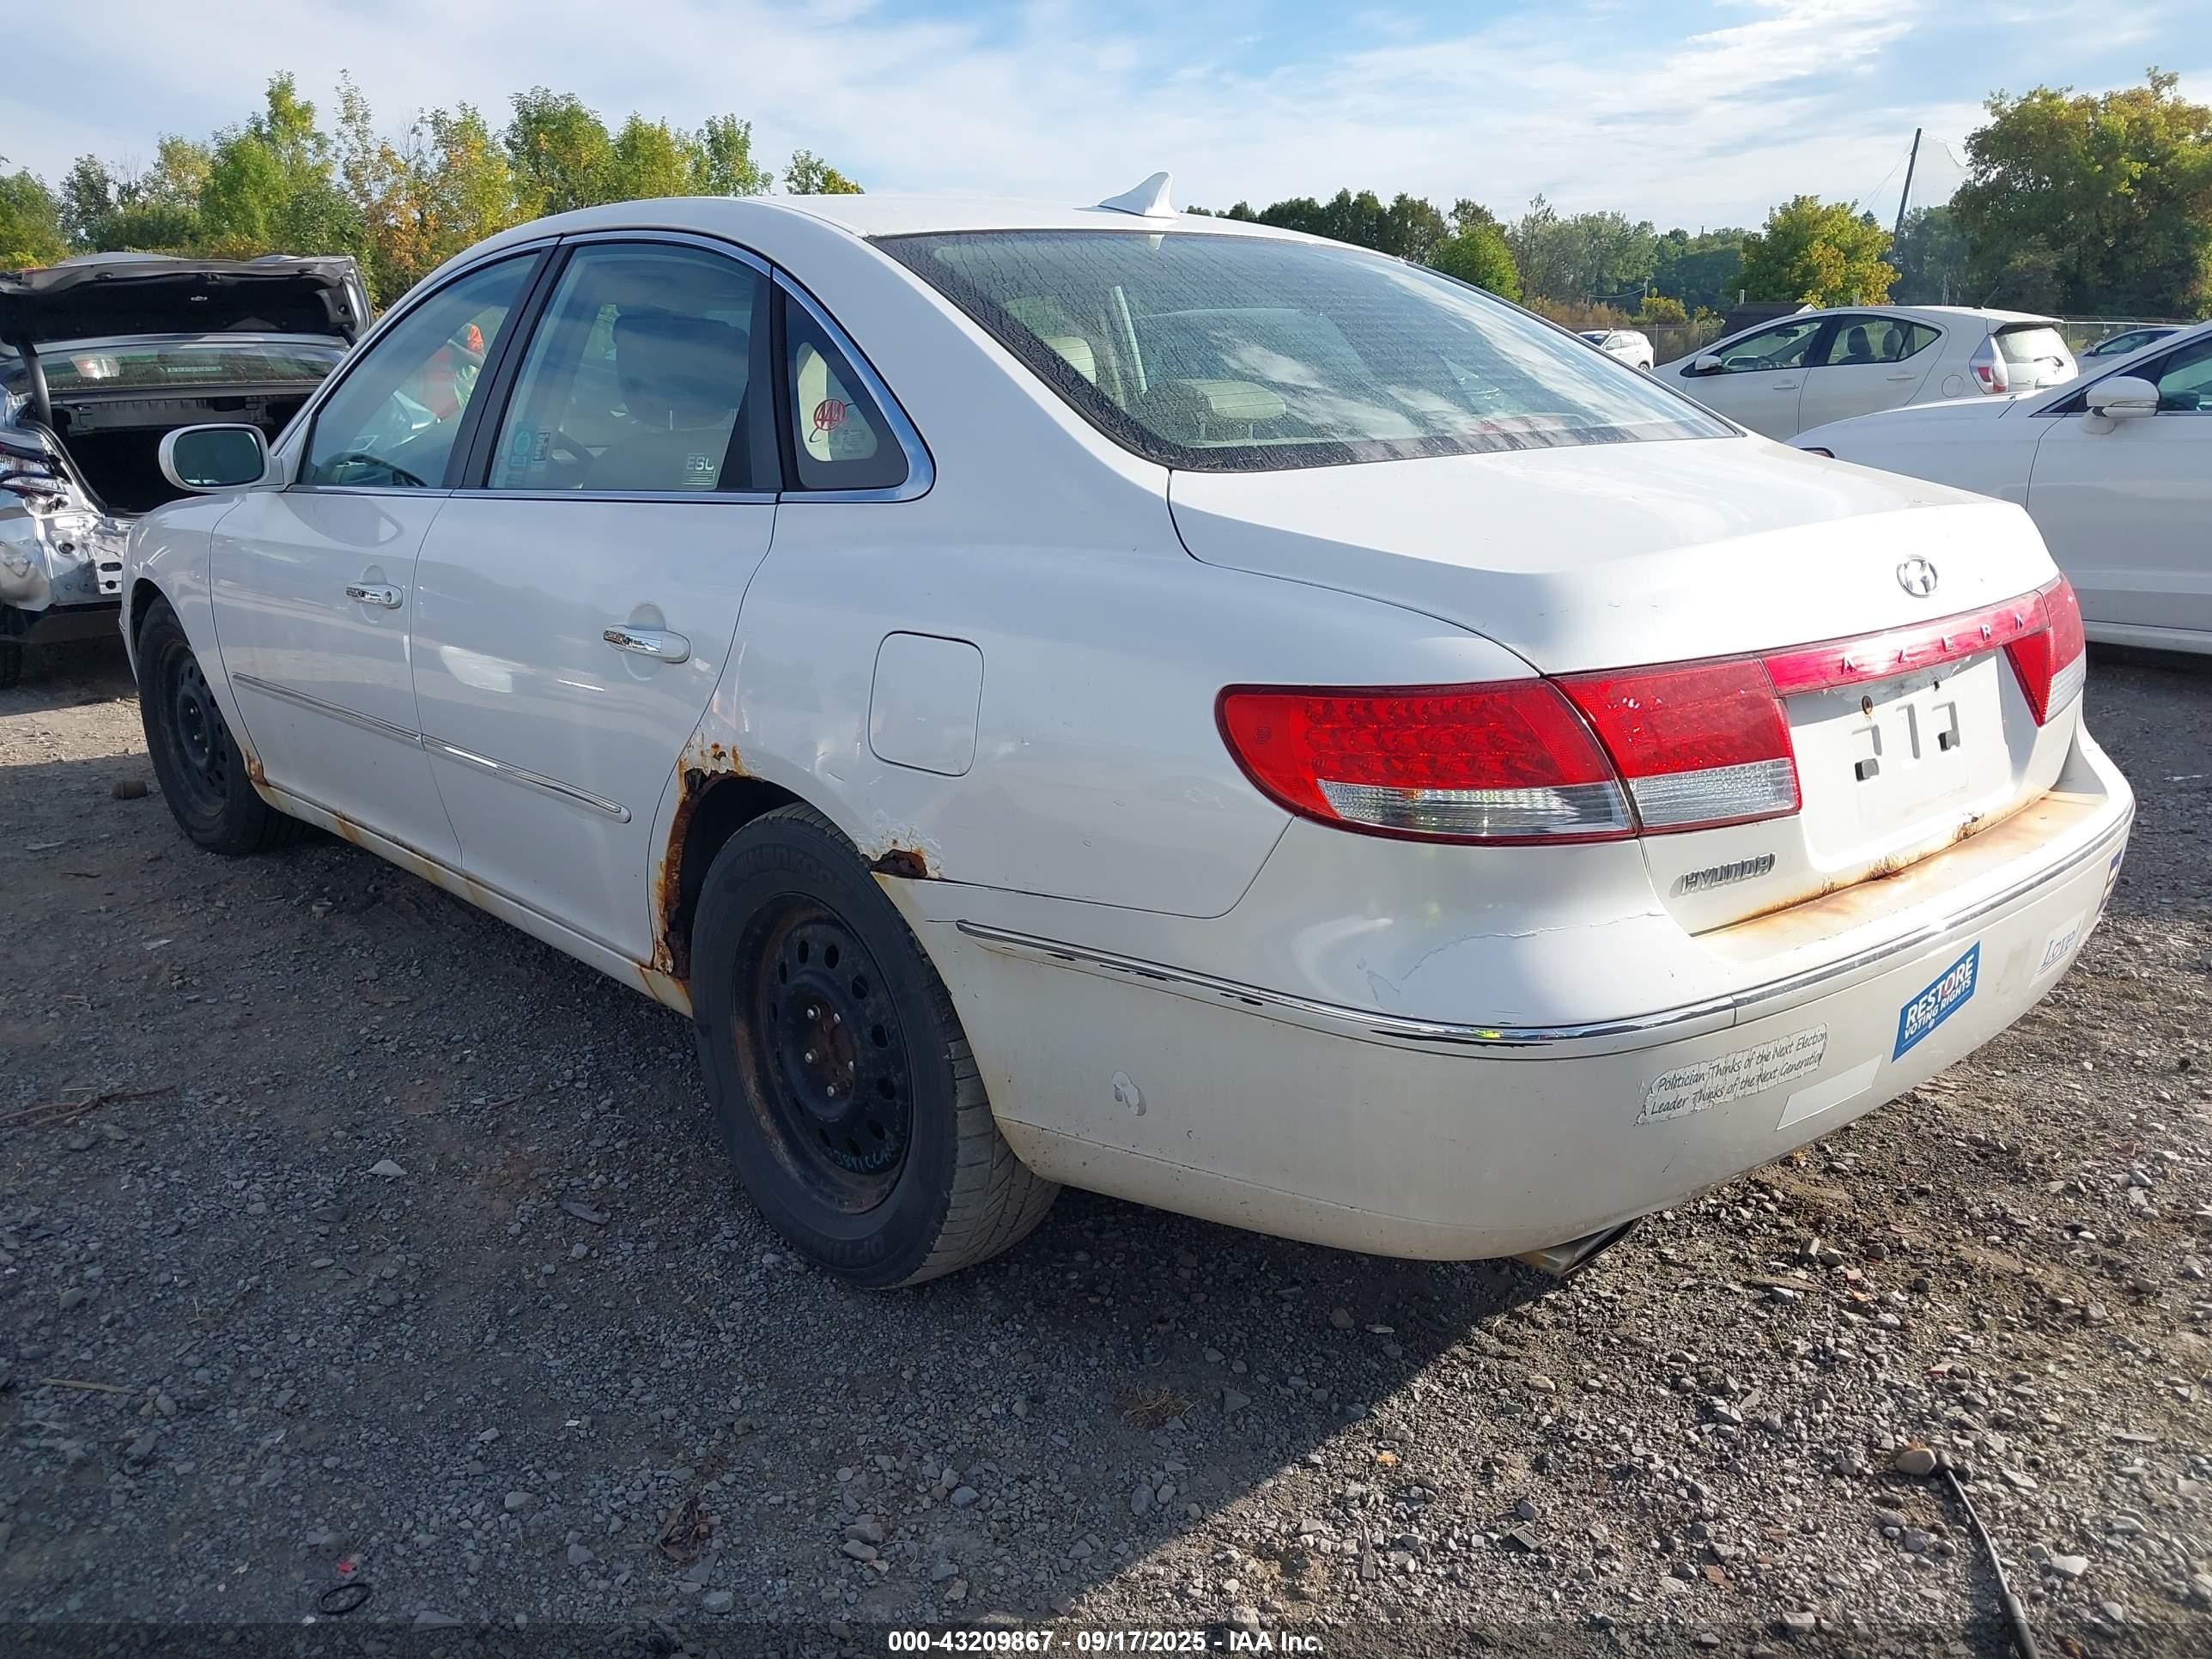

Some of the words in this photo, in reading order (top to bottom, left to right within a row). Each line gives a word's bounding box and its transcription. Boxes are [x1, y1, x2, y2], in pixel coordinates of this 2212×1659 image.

[815, 400, 844, 428] AAA
[1841, 613, 2024, 675] AZERA
[1682, 853, 1776, 894] HYUNDAI
[1905, 953, 1975, 1029] RESTORE
[1905, 1004, 1939, 1040] VOTING
[1941, 975, 1972, 1010] RIGHTS
[1650, 1094, 1689, 1115] Leader
[1692, 1083, 1725, 1105] Thinks
[1727, 1077, 1741, 1096] of
[1740, 1074, 1755, 1090] the
[1756, 1066, 1779, 1085] Next
[1657, 1069, 1705, 1093] Politician
[1709, 1056, 1742, 1078] Thinks
[1744, 1050, 1756, 1069] of
[1756, 1049, 1771, 1065] the
[1772, 1041, 1795, 1060] Next
[1796, 1029, 1826, 1051] Election
